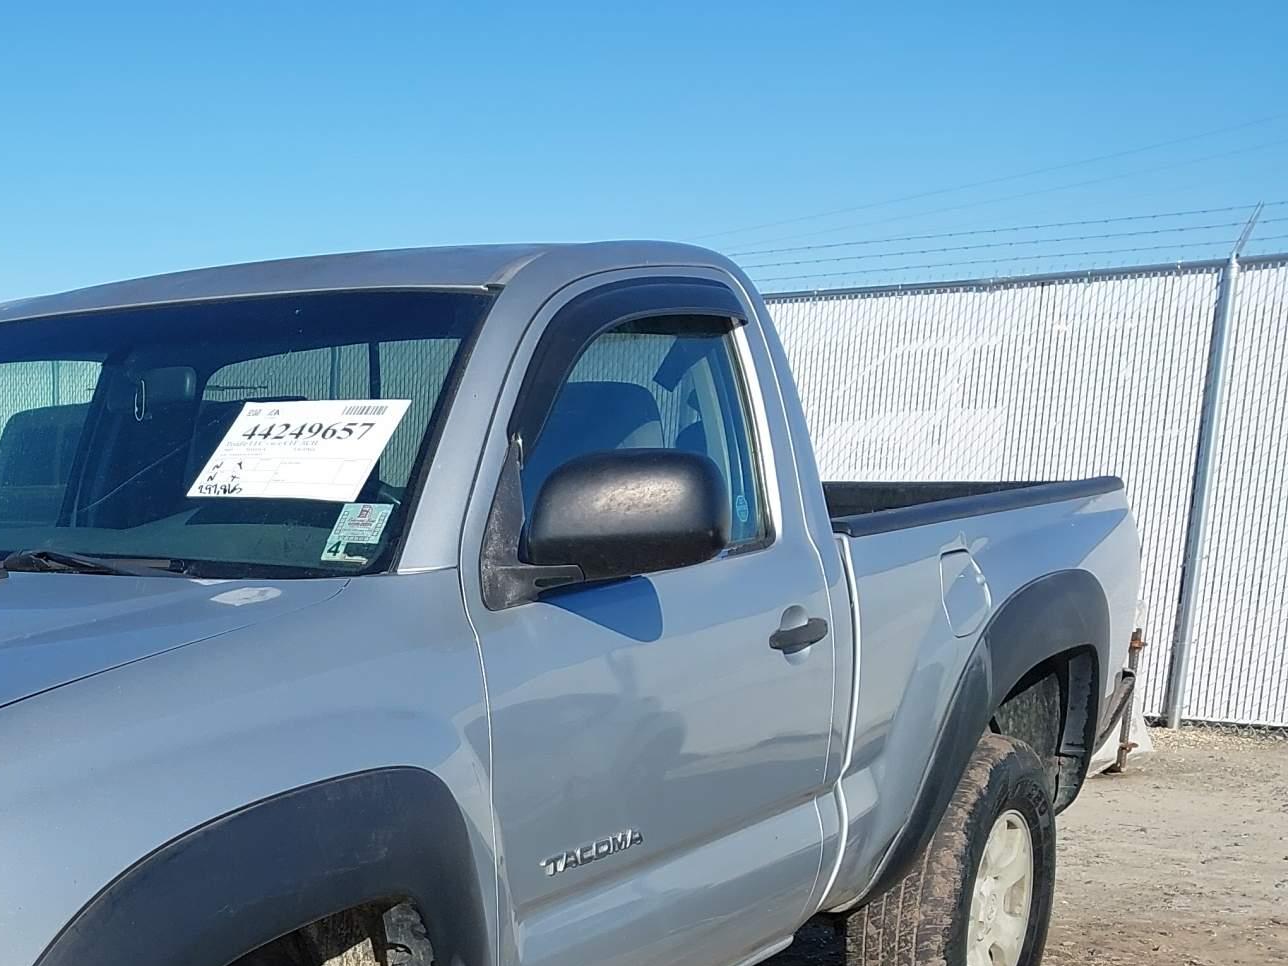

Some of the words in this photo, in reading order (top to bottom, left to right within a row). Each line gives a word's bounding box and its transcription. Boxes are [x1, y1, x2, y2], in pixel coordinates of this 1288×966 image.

[242, 422, 376, 440] 44249657
[326, 540, 342, 557] 4
[539, 829, 644, 876] TACOMA
